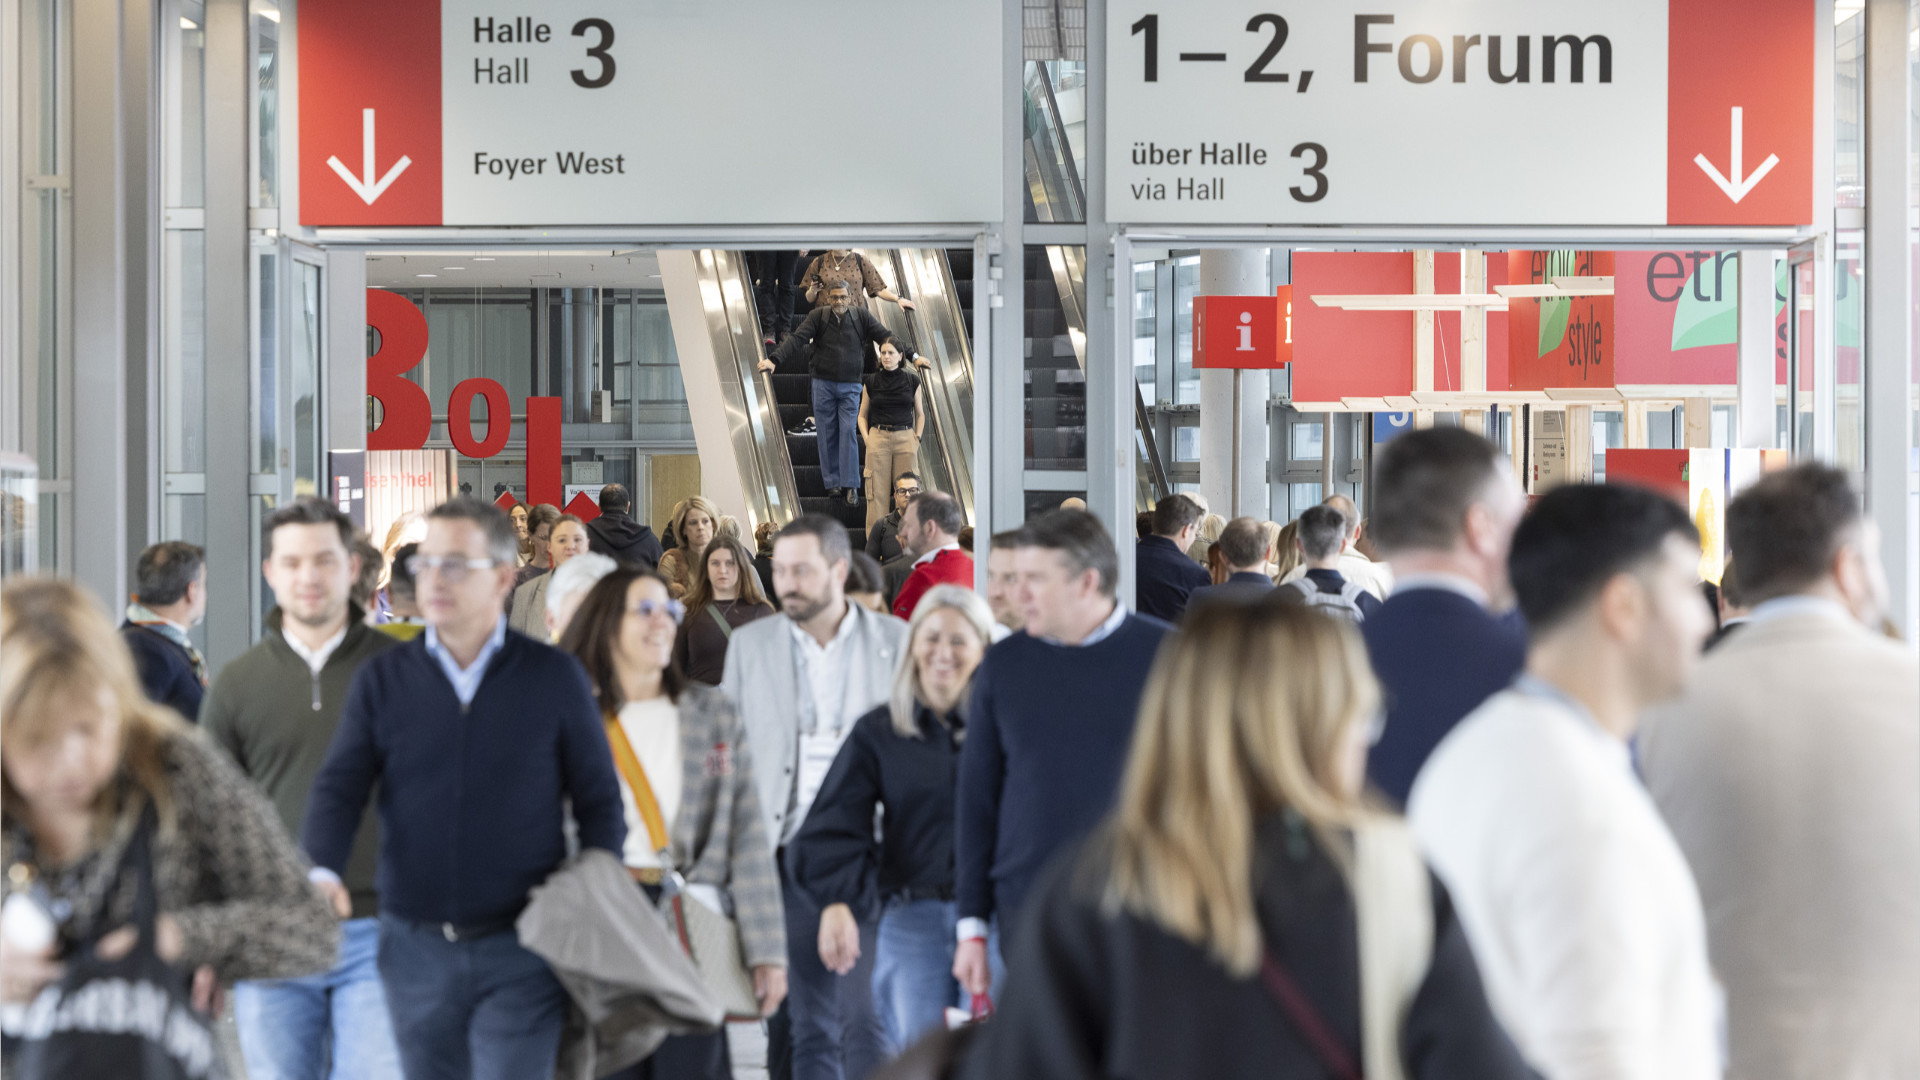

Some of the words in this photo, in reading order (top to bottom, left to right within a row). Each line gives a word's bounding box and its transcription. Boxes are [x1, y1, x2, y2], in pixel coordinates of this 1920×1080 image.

[473, 16, 552, 44] Halle
[570, 17, 617, 89] 3
[1353, 14, 1614, 84] Forum
[474, 57, 529, 84] Hall
[473, 152, 547, 180] Foyer
[555, 151, 625, 175] West
[1131, 142, 1193, 165] über
[1200, 142, 1268, 165] Halle
[1289, 141, 1329, 203] 3
[1131, 177, 1167, 200] via
[1176, 177, 1225, 200] Hall
[1568, 303, 1602, 380] style
